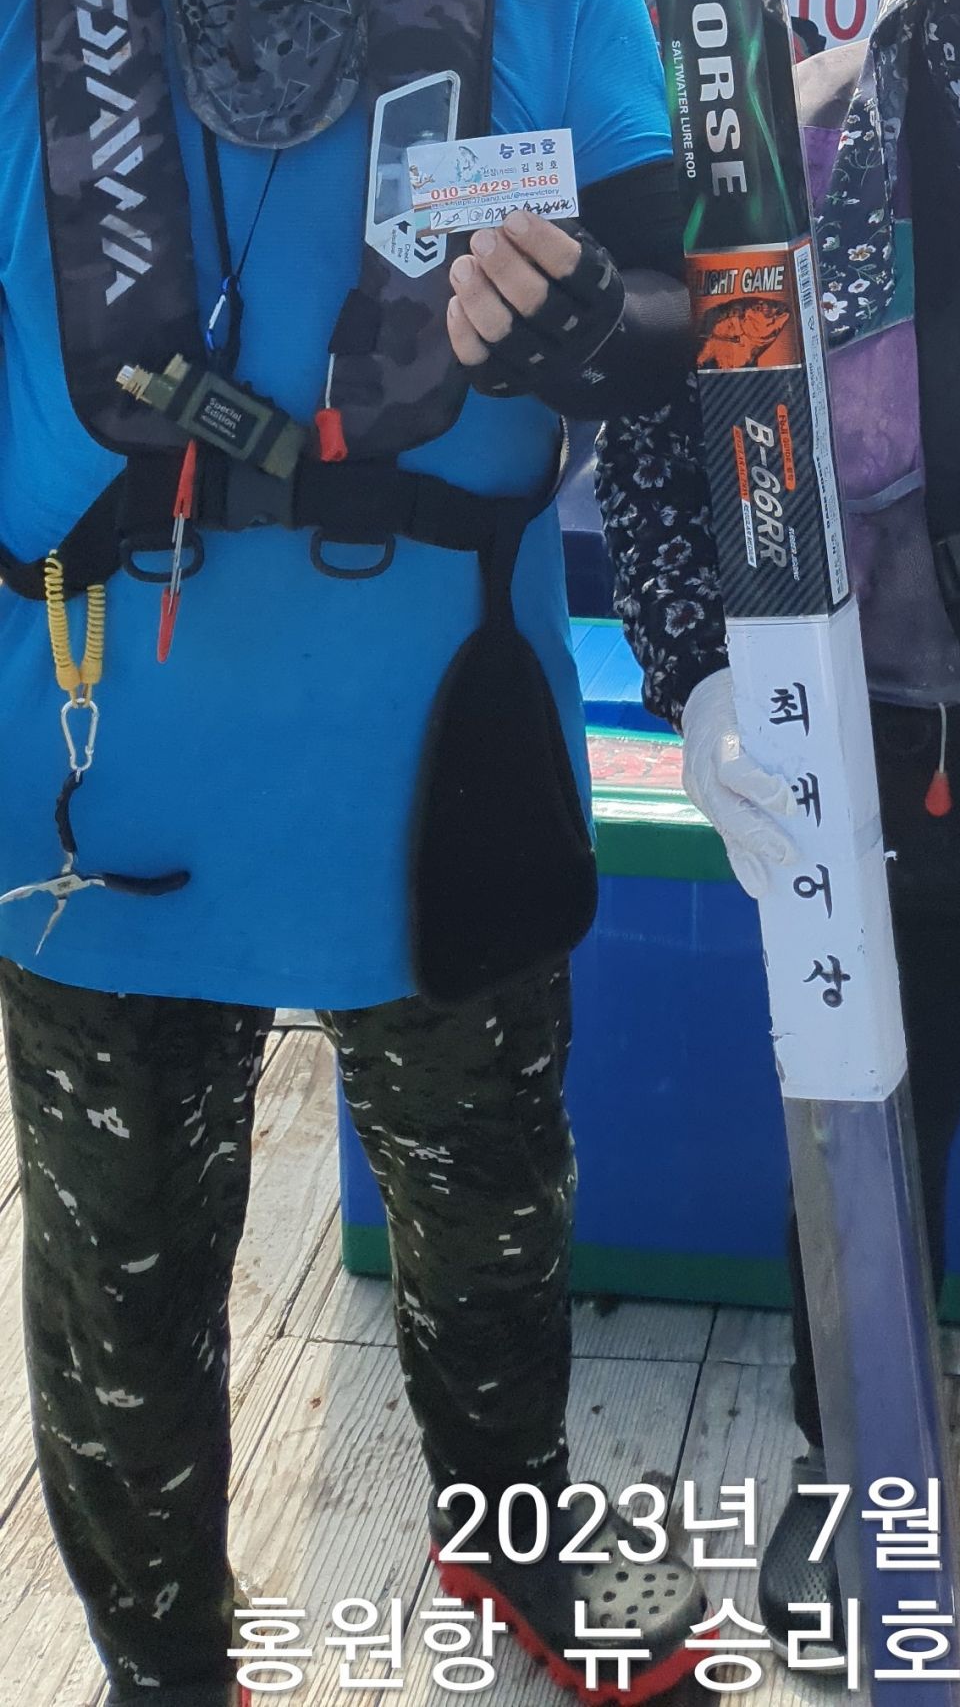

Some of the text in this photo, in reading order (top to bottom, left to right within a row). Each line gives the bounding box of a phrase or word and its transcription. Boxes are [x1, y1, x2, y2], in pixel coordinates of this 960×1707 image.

[672, 40, 697, 179] SALTWATER LURE ROD
[500, 139, 556, 160] 승리호
[430, 173, 560, 201] 010-3429-1586
[696, 265, 785, 295] LIGHT GAME
[204, 405, 237, 430] Edition
[209, 397, 242, 422] Special
[744, 416, 788, 568] B-66RR
